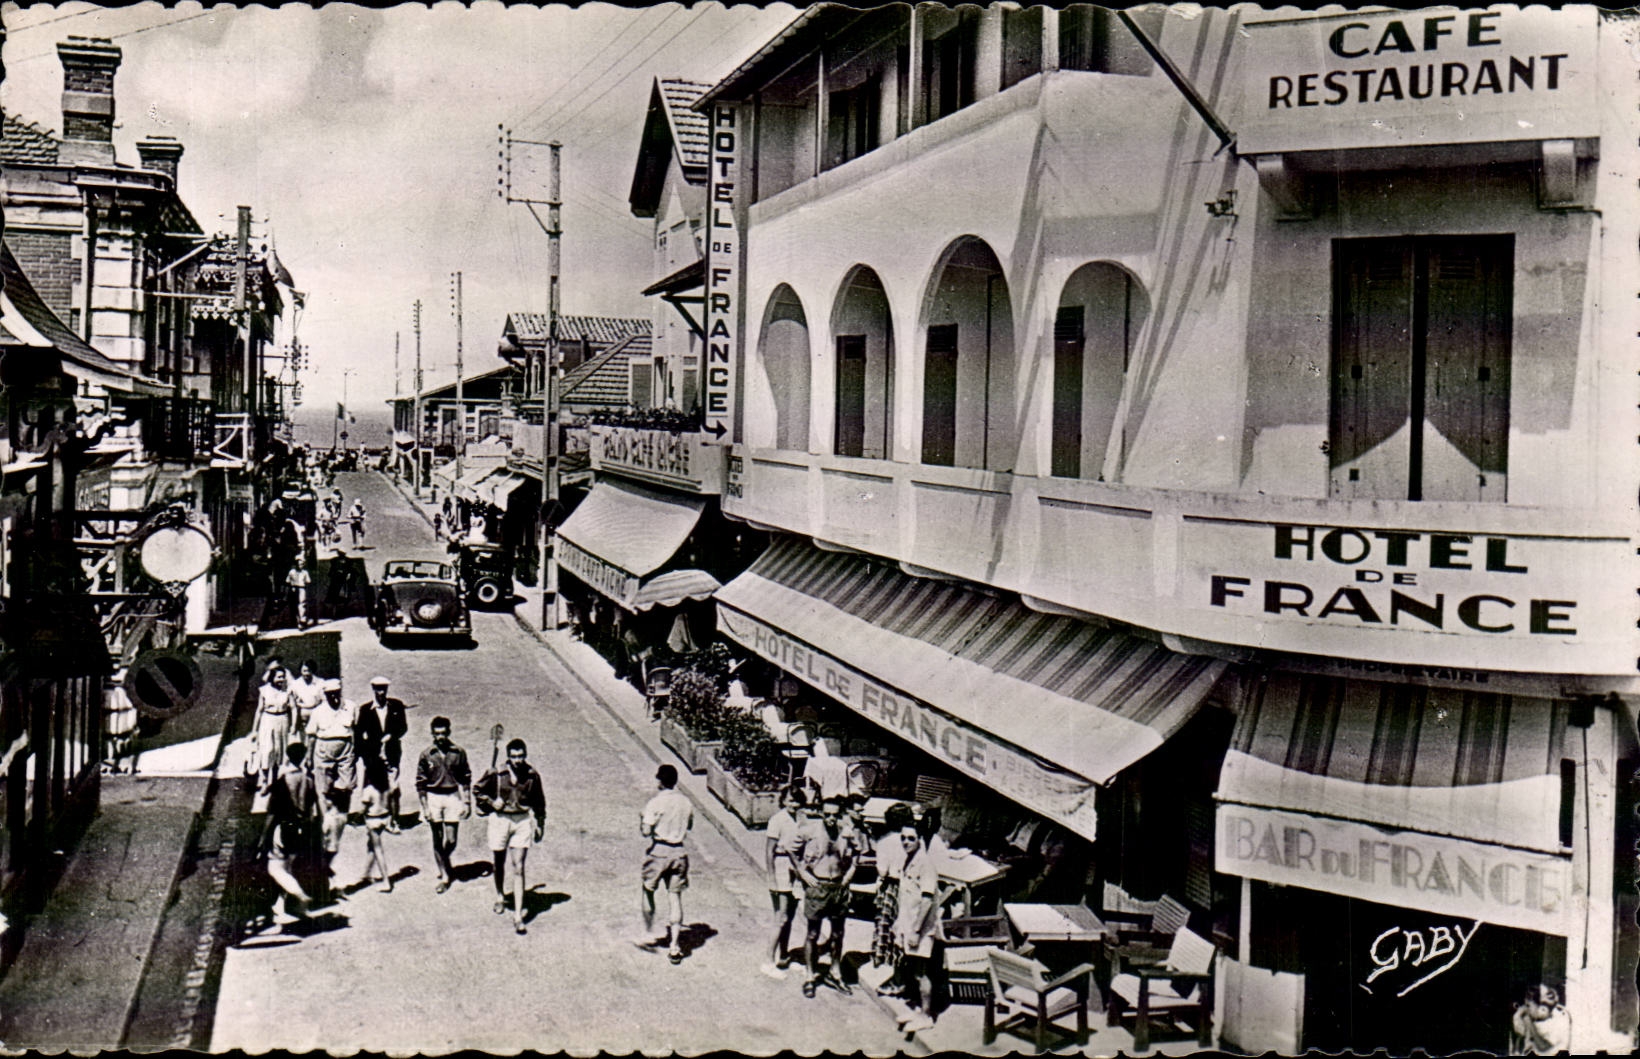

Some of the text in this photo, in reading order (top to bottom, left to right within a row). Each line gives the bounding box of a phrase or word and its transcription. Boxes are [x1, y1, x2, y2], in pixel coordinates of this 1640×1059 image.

[1329, 12, 1501, 59] CAFE
[1268, 54, 1568, 109] RESTAURANT
[709, 107, 735, 413] HOTEL DE FRANCE
[1274, 525, 1529, 574] HOTEL
[1355, 569, 1418, 587] DE
[1210, 575, 1578, 636] FRANCE
[754, 626, 821, 683] HOTEL
[826, 670, 850, 699] DE
[861, 681, 988, 776] FRANCE
[1225, 814, 1562, 914] BAR DU FRANCE
